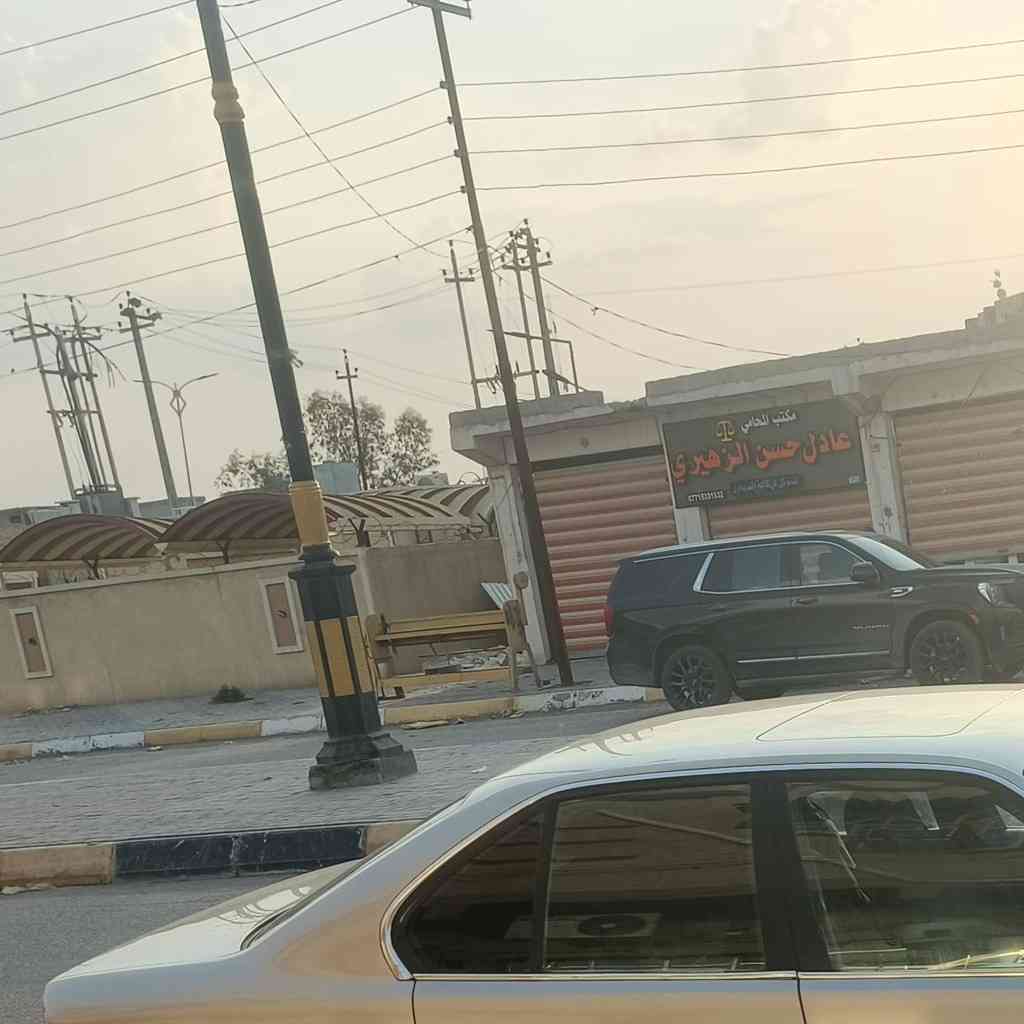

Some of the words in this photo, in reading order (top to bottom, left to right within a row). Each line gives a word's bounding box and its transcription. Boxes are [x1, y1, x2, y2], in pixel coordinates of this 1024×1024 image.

[740, 414, 769, 433] المحامي
[773, 409, 796, 428] مكتب
[756, 439, 800, 470] حسن
[803, 429, 849, 464] عادل
[673, 441, 750, 484] الزهيري
